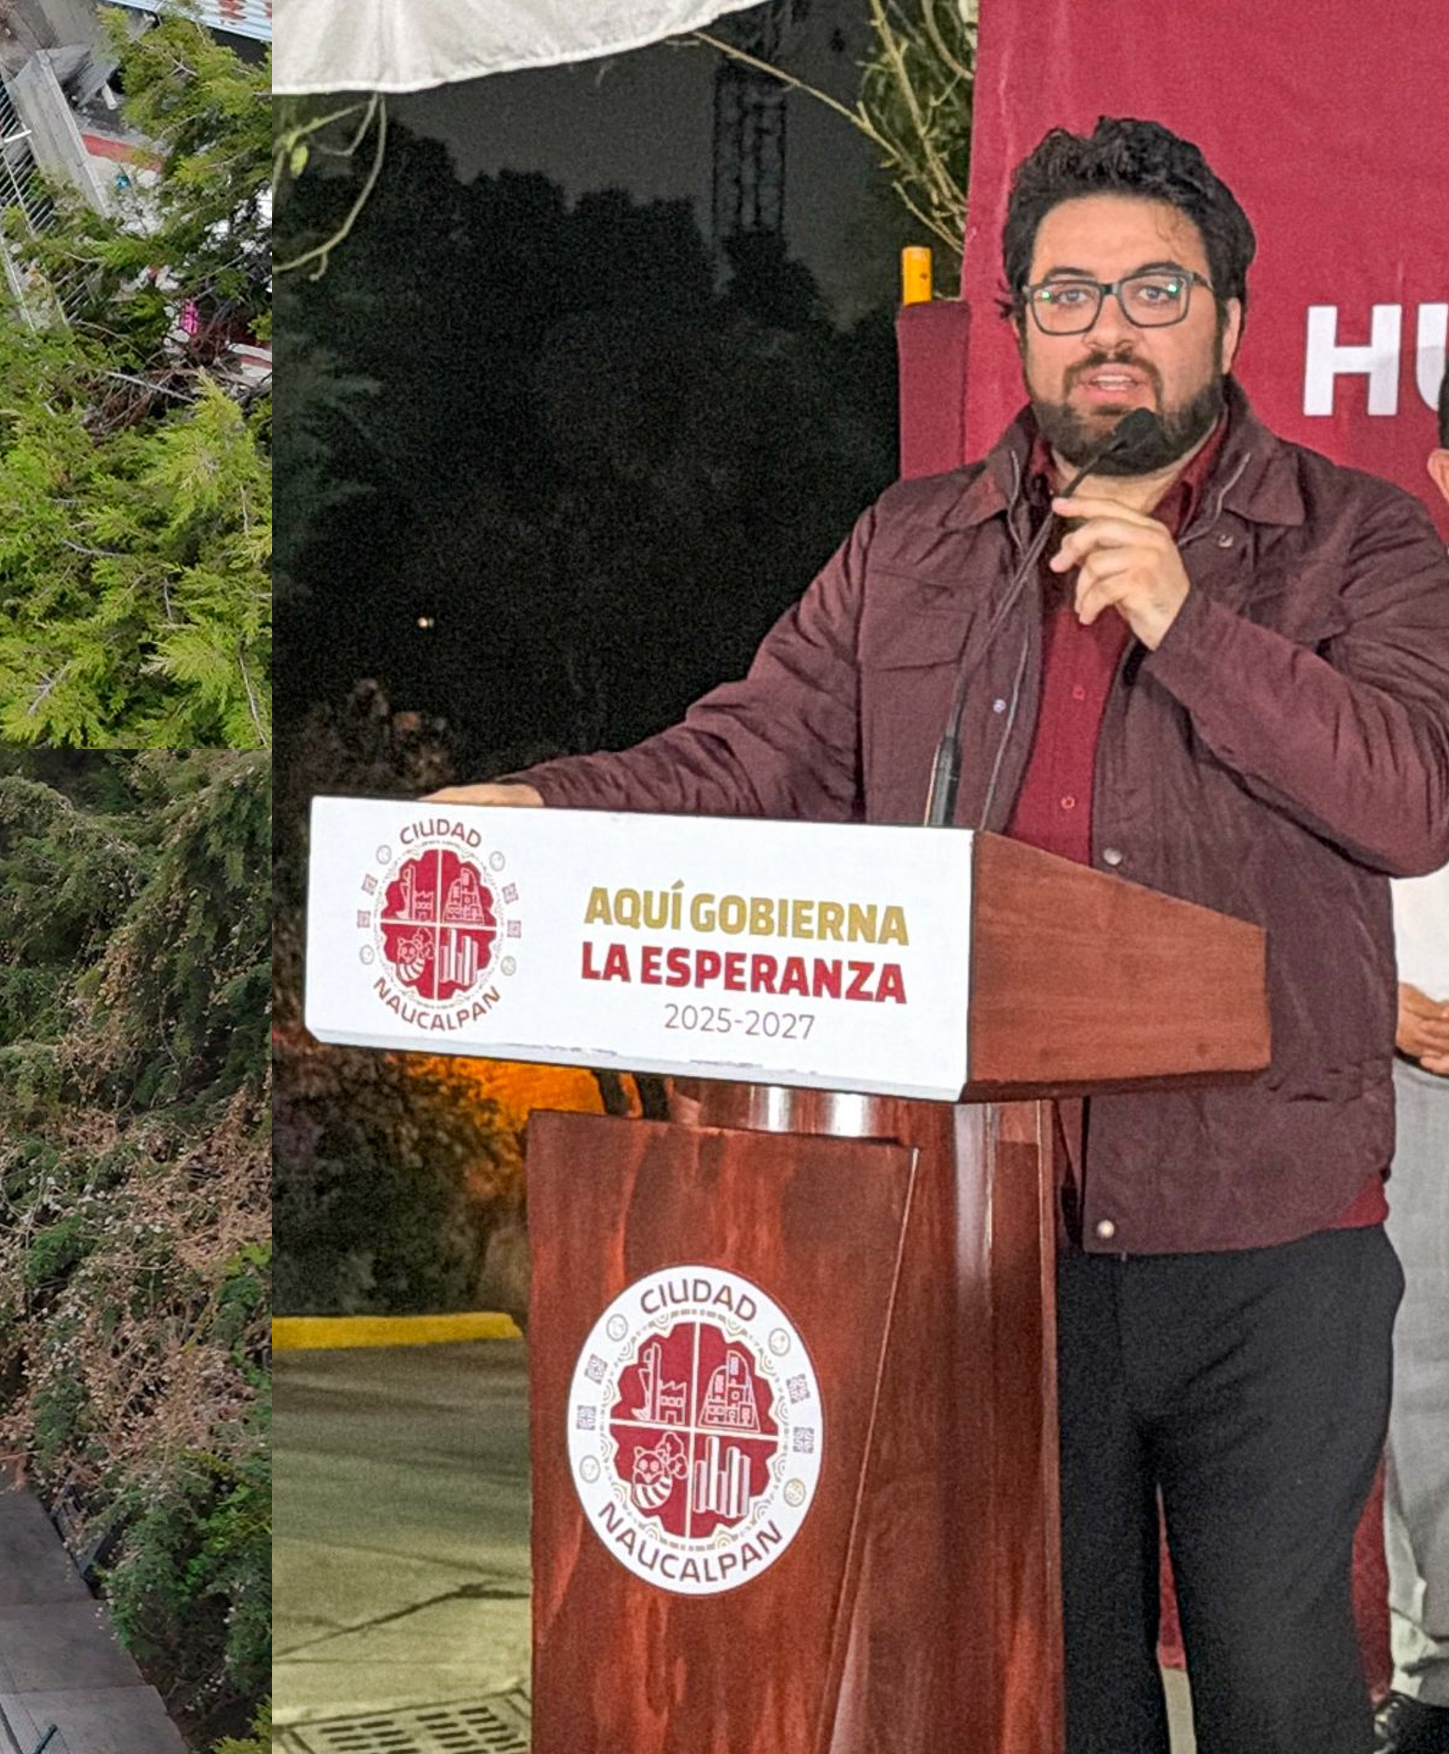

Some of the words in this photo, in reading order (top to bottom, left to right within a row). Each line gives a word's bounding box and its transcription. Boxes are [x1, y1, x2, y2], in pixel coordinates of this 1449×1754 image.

[399, 818, 482, 849] CIUDAD
[584, 879, 684, 932] AQUÍ
[690, 891, 910, 946] GOBIERNA
[580, 941, 635, 983] LA
[640, 946, 908, 1004] ESPERANZA
[373, 976, 501, 1032] NAUCALPAN
[664, 1003, 816, 1041] 2025-2027
[640, 1278, 757, 1322] CIUDAD
[598, 1501, 783, 1583] NAUCALPAN
